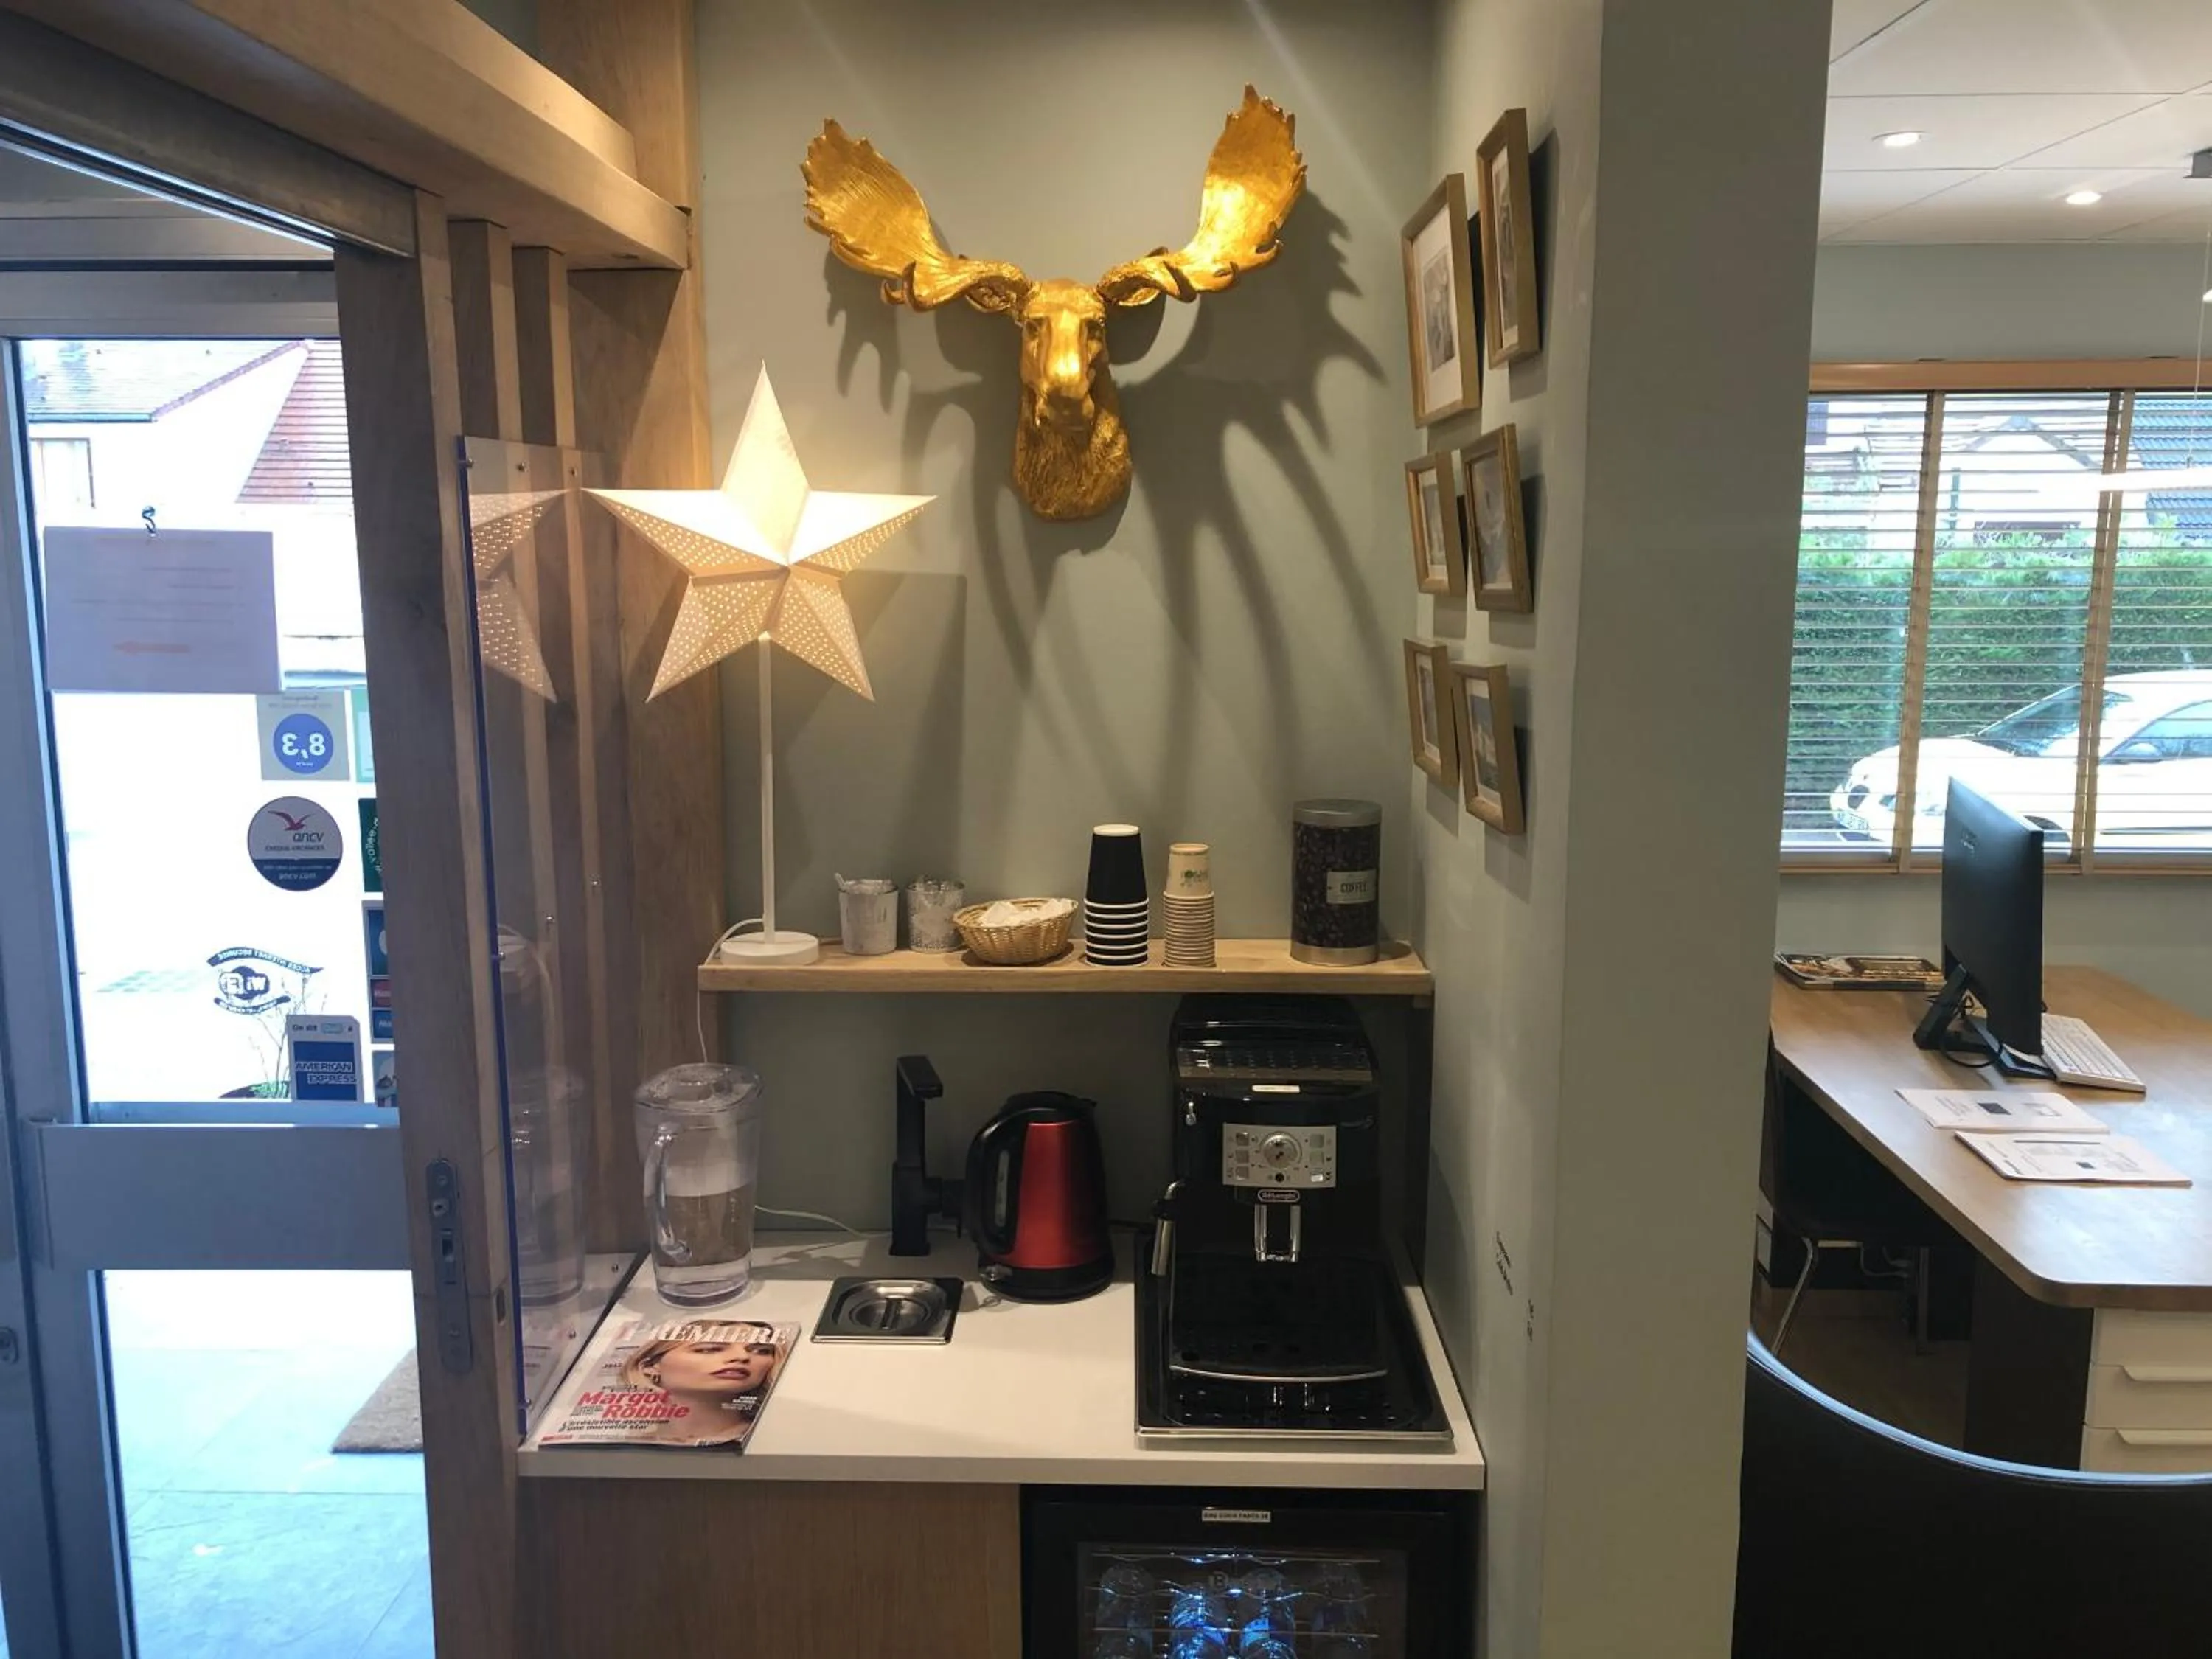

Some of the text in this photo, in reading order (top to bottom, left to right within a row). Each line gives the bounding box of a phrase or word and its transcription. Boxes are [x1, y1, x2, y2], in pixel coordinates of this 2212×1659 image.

[293, 832, 324, 842] ancv
[294, 1062, 353, 1073] AMERICAN
[306, 1073, 358, 1085] EXPRESS
[577, 1390, 671, 1406] Margot
[602, 1402, 690, 1419] Robbie
